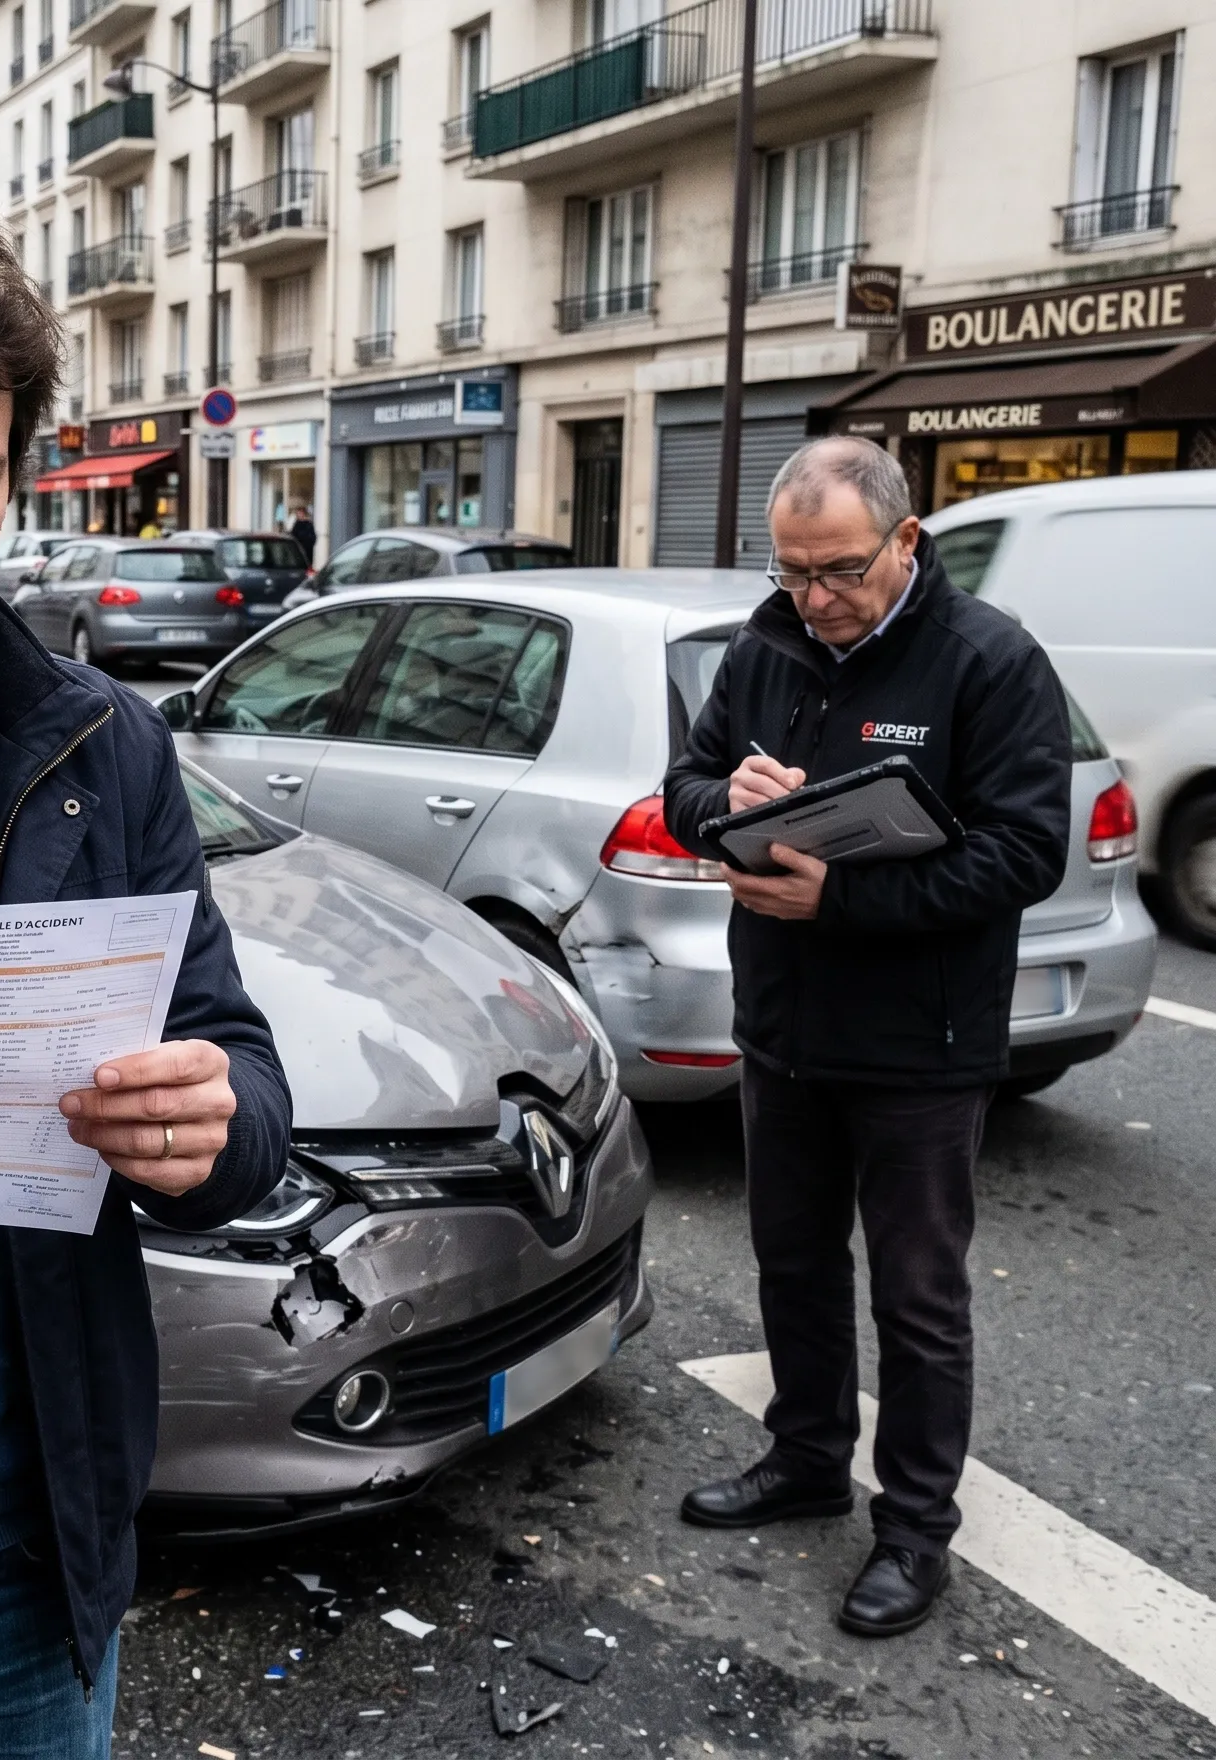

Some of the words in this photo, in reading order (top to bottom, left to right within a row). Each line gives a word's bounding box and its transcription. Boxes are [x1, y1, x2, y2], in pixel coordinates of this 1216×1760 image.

[927, 284, 1186, 351] BOULANGERIE
[908, 404, 1042, 432] BOULANGERIE
[15, 917, 85, 929] D'ACCIDENT
